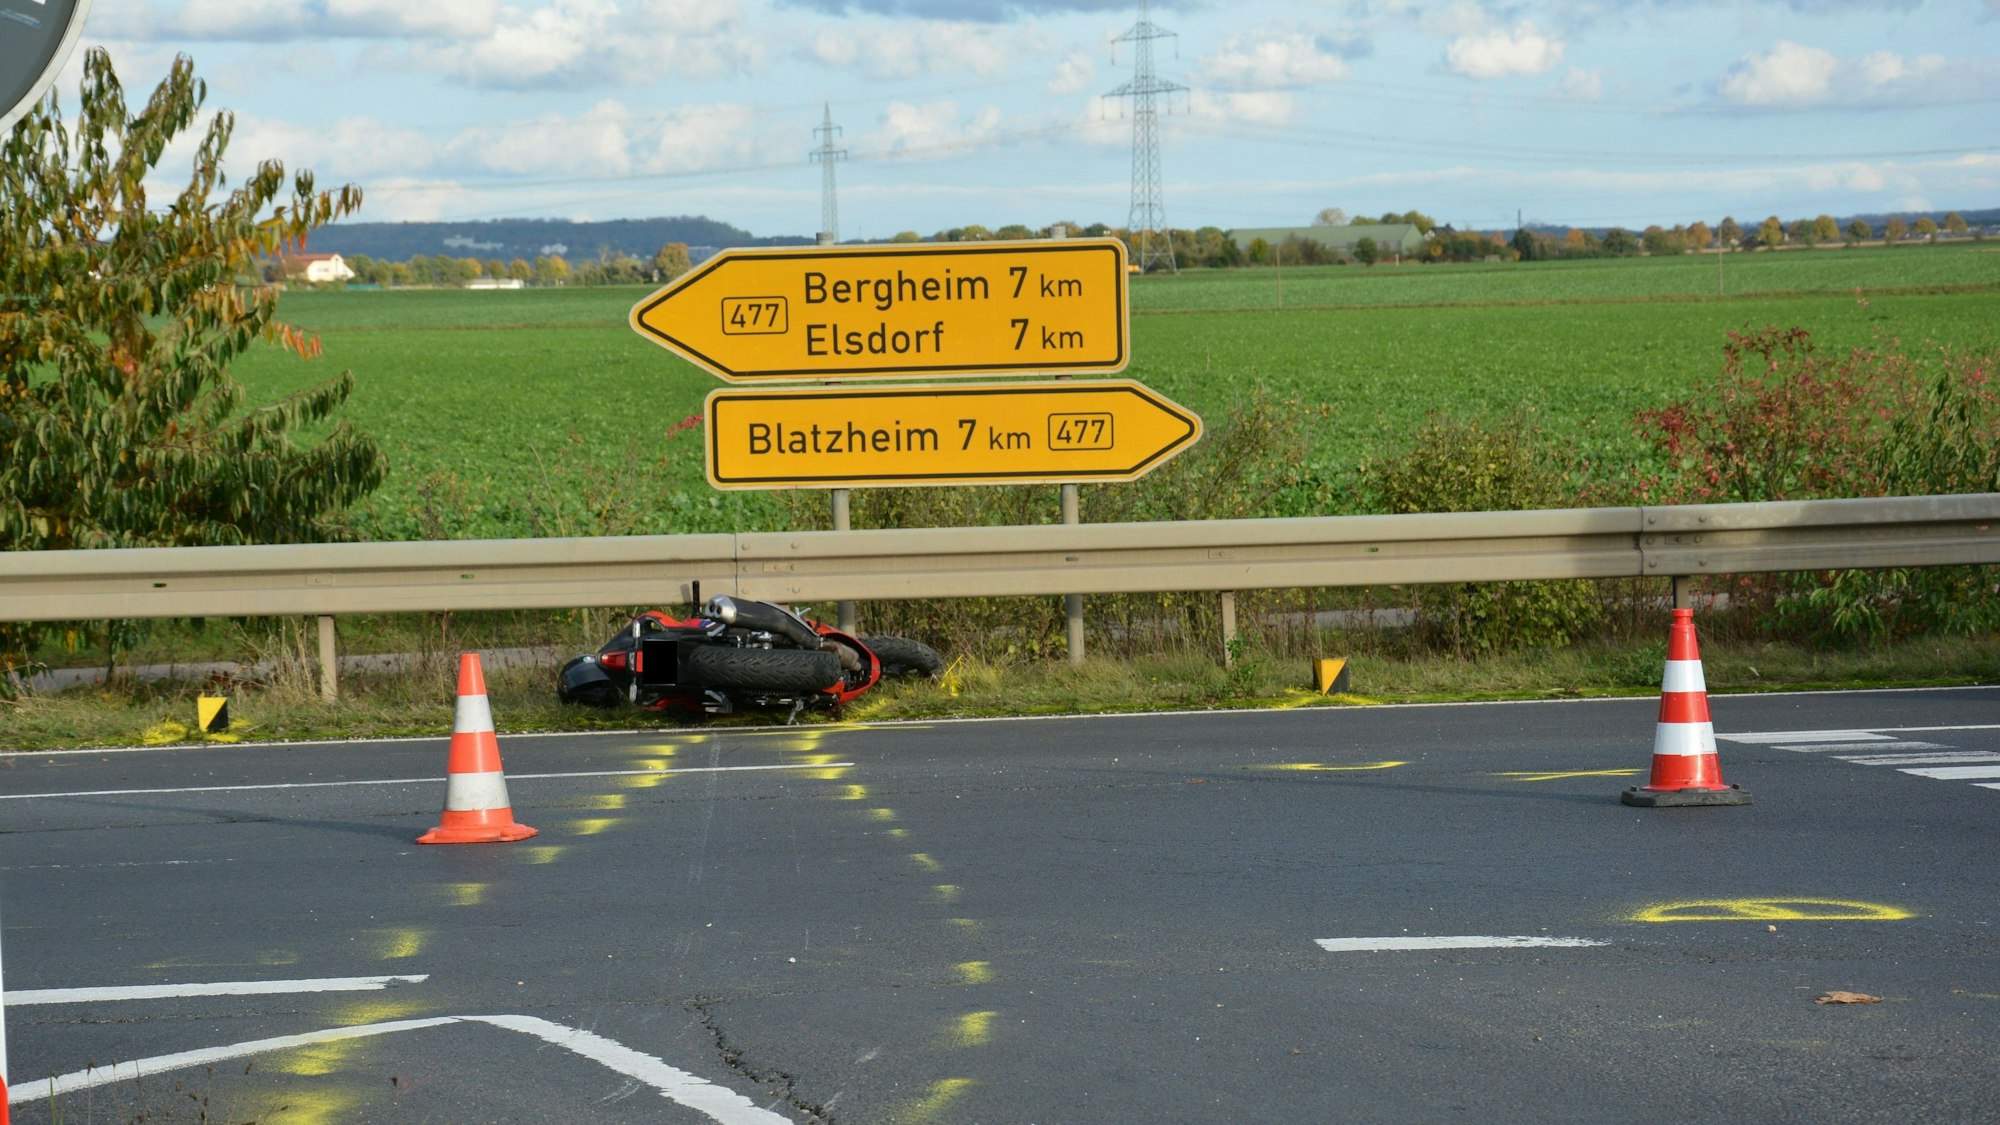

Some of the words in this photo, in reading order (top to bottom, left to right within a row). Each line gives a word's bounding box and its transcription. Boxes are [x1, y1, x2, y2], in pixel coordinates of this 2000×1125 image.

[804, 268, 989, 312] Bergheim
[1009, 266, 1028, 299] 7
[1040, 273, 1083, 298] km
[730, 303, 780, 328] 477
[806, 320, 944, 356] Elsdorf
[1010, 318, 1029, 351] 7
[1041, 325, 1084, 350] km
[749, 420, 939, 455] Blatzheim
[958, 418, 977, 451] 7
[989, 426, 1031, 450] km
[1056, 419, 1105, 444] 477
